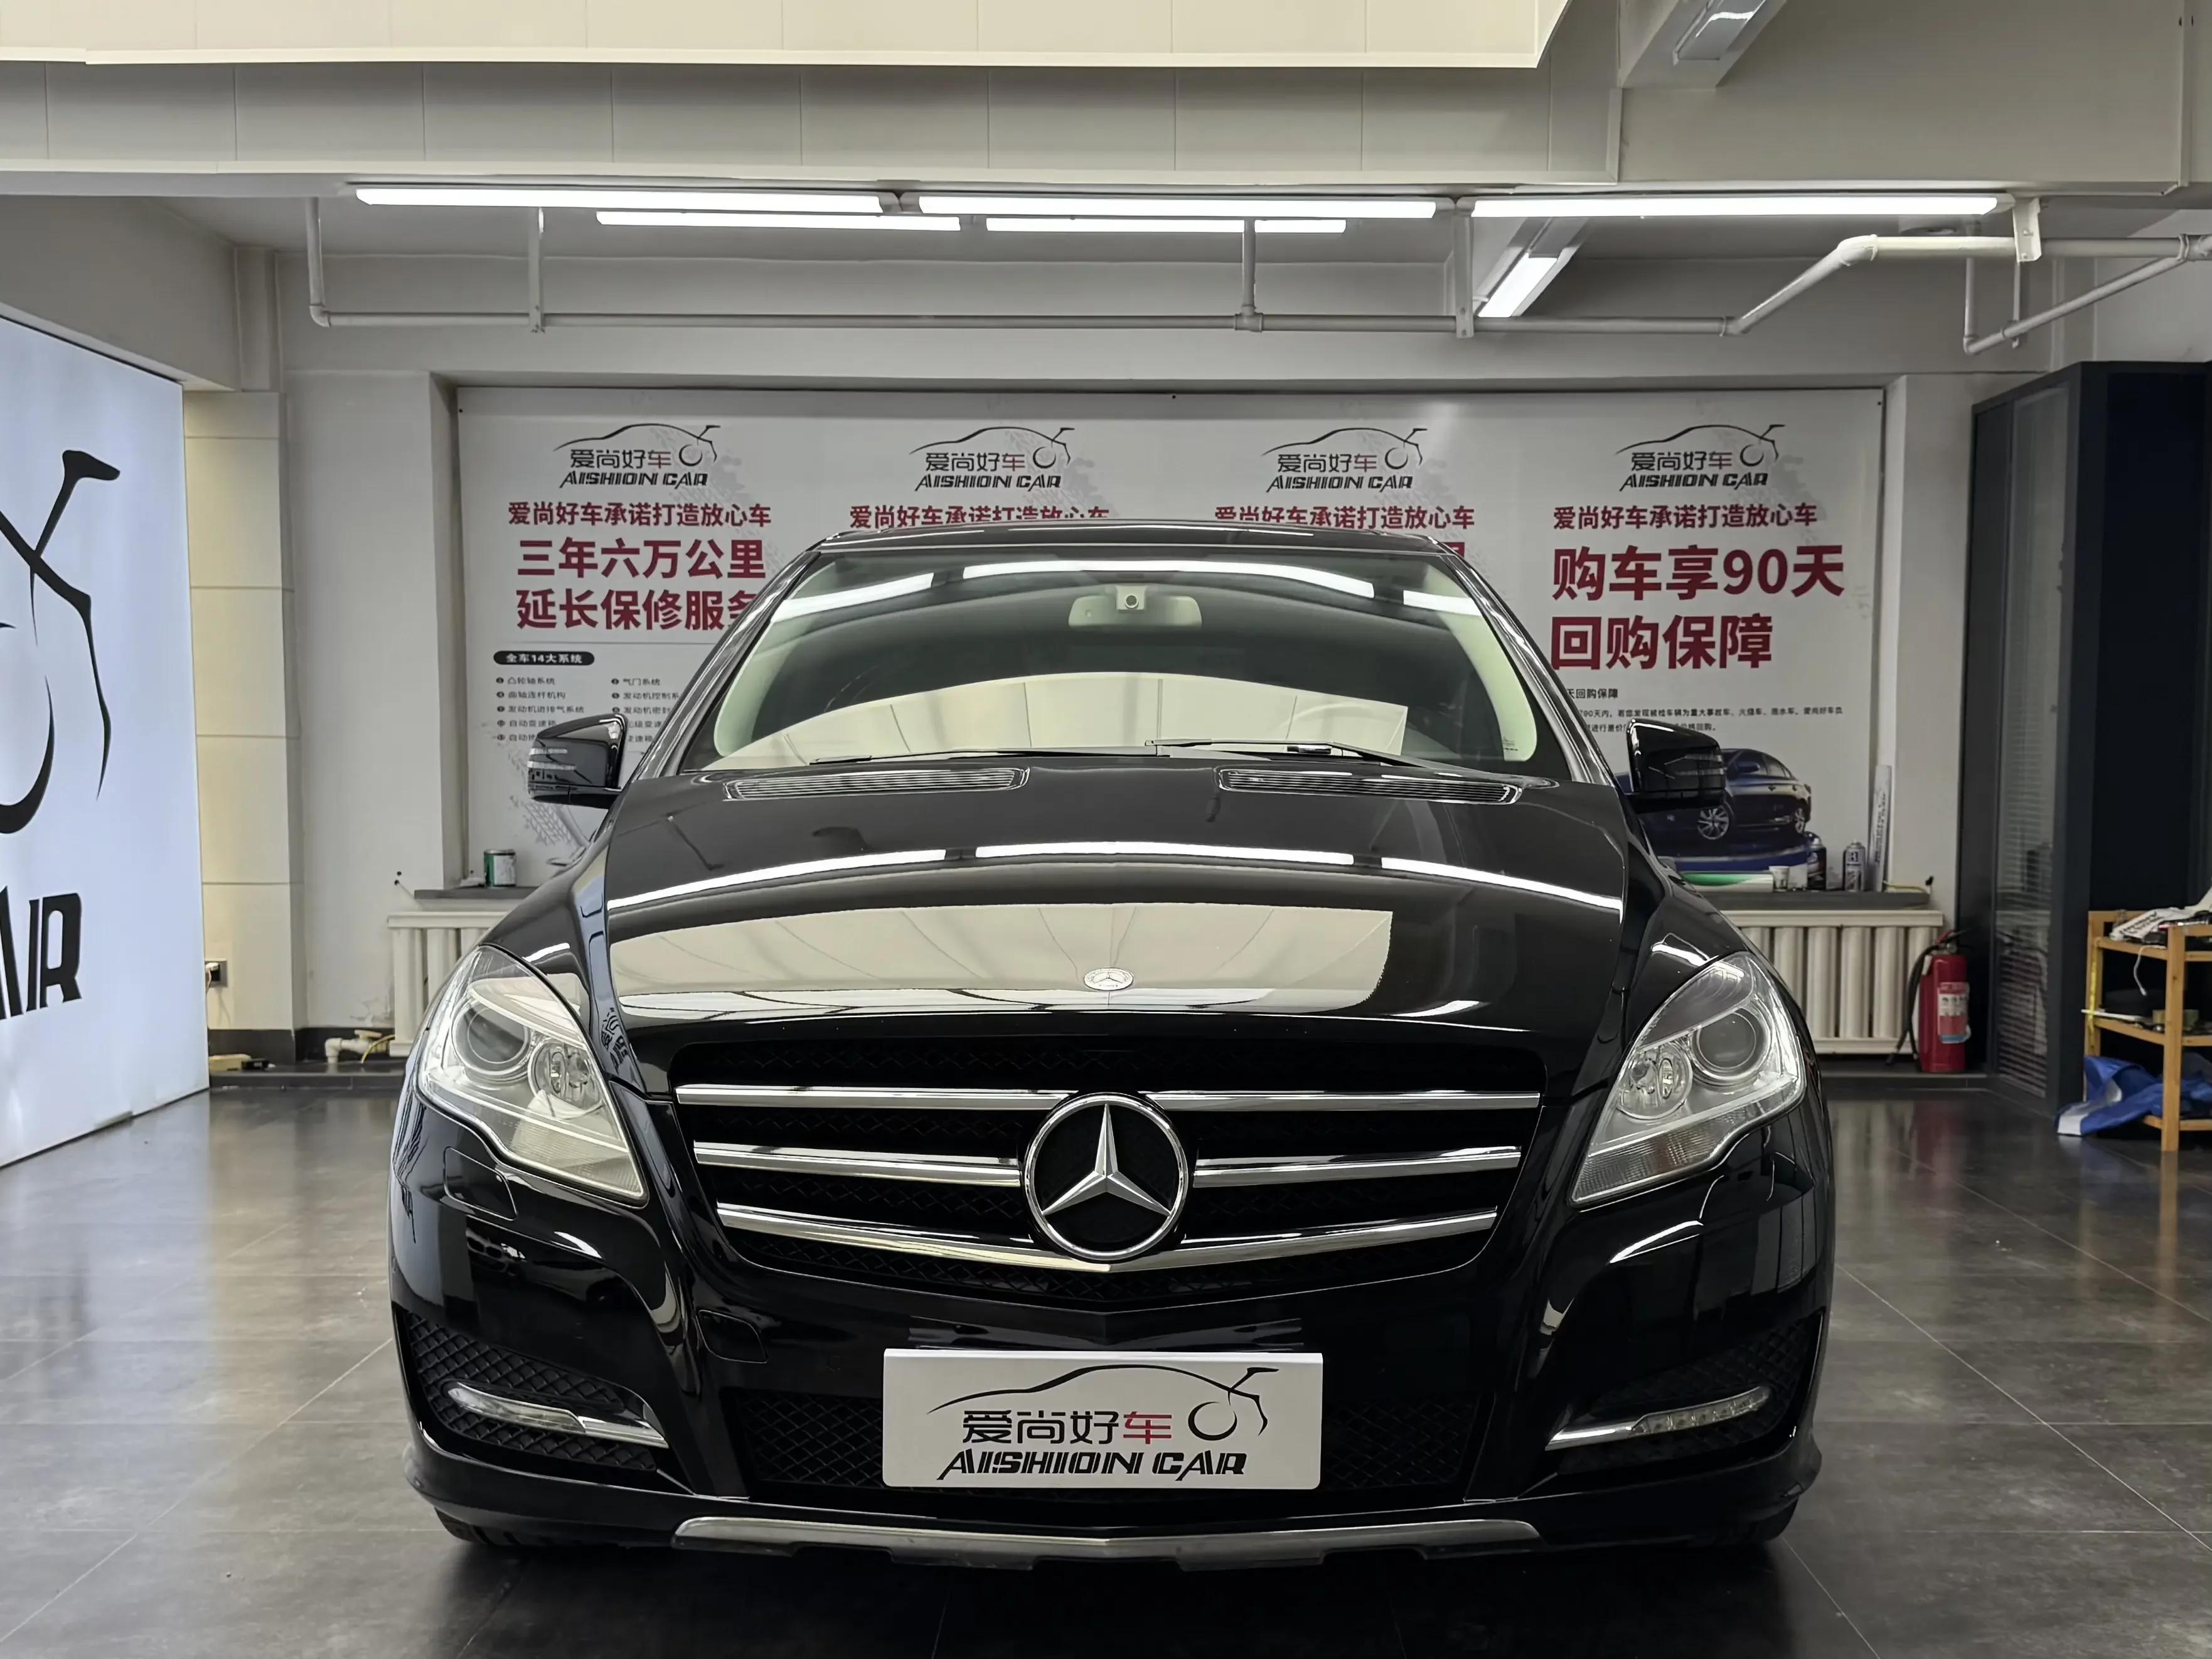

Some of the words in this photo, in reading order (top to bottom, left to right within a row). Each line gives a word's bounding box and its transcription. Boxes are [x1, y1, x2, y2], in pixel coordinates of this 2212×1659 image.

[570, 449, 671, 469] 爱尚好车
[926, 452, 1025, 472] 爱尚好车
[1278, 454, 1377, 473] 爱尚好车
[1632, 451, 1733, 472] 爱尚好车
[560, 471, 659, 489] AISHION
[663, 471, 708, 489] CAR
[915, 474, 1012, 492] AISHION
[1016, 474, 1062, 492] CAR
[1266, 475, 1364, 493] AISHION
[1368, 475, 1414, 493] CAR
[1619, 473, 1719, 492] AISHION
[1723, 472, 1768, 491] CAR
[508, 501, 772, 528] 爱尚好车承诺打造放心车
[1553, 502, 1818, 530] 爱尚好车承诺打造放心车
[517, 537, 766, 580] 三年六万公里
[1552, 544, 1846, 602] 购车享90天
[1551, 612, 1773, 671] 回购保障
[506, 653, 583, 664] 全车14大系统
[963, 1409, 1173, 1446] 爱尚好车
[937, 1448, 1145, 1481] AISHION
[1152, 1449, 1248, 1482] CAR
